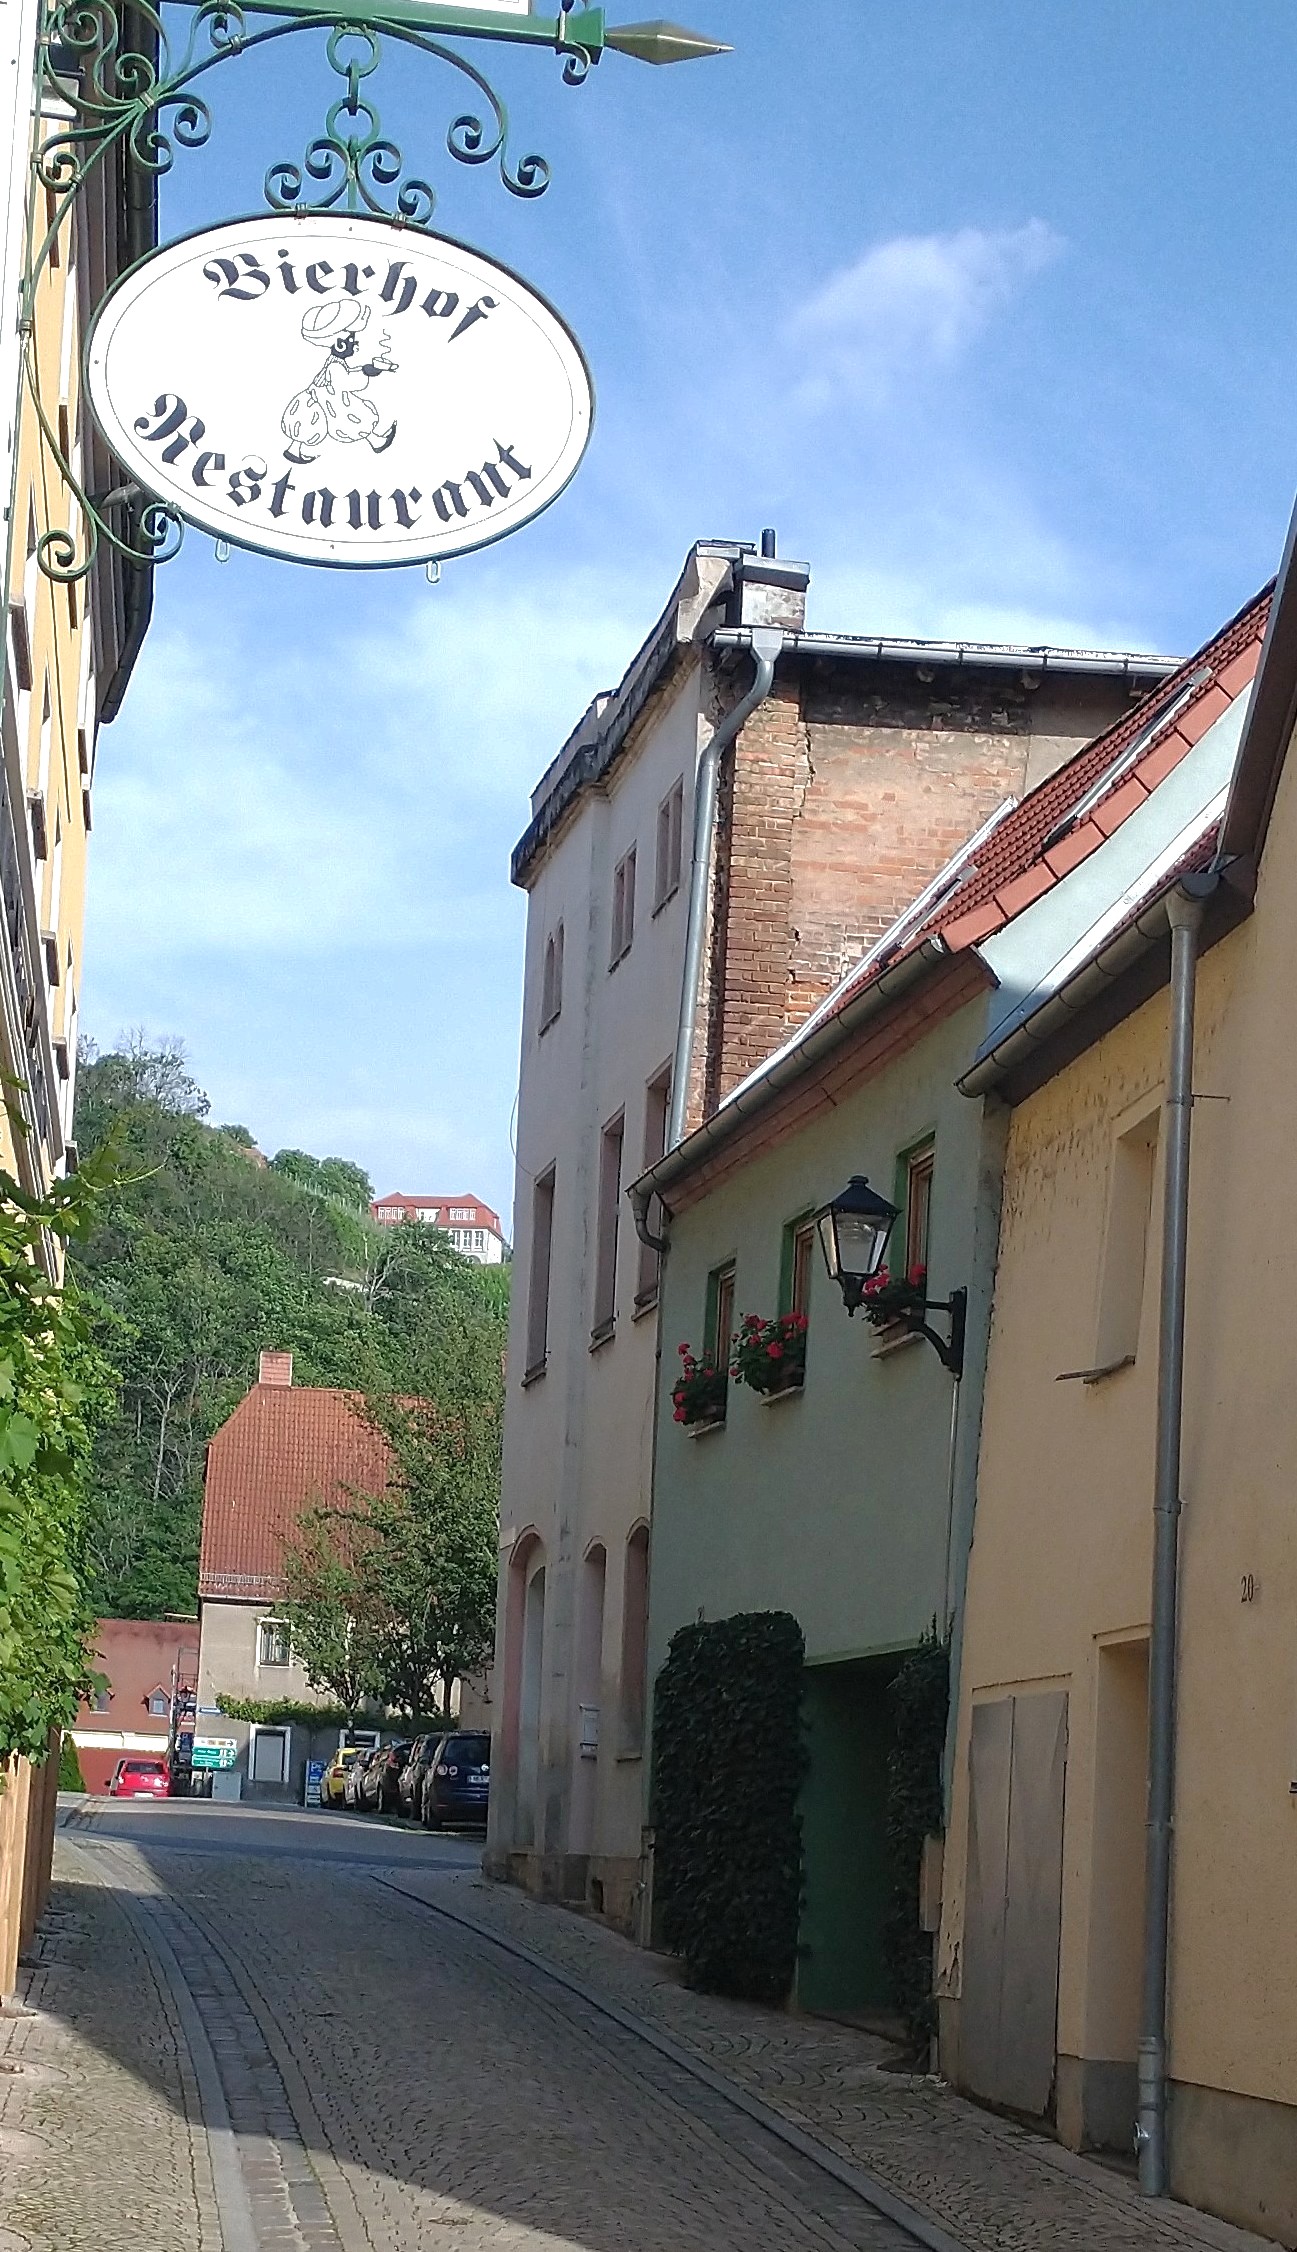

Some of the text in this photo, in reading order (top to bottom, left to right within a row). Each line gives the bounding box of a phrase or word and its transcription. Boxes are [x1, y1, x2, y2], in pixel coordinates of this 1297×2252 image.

[202, 248, 500, 343] Bierhof
[133, 393, 532, 531] Restaurant
[1240, 1574, 1254, 1603] 20
